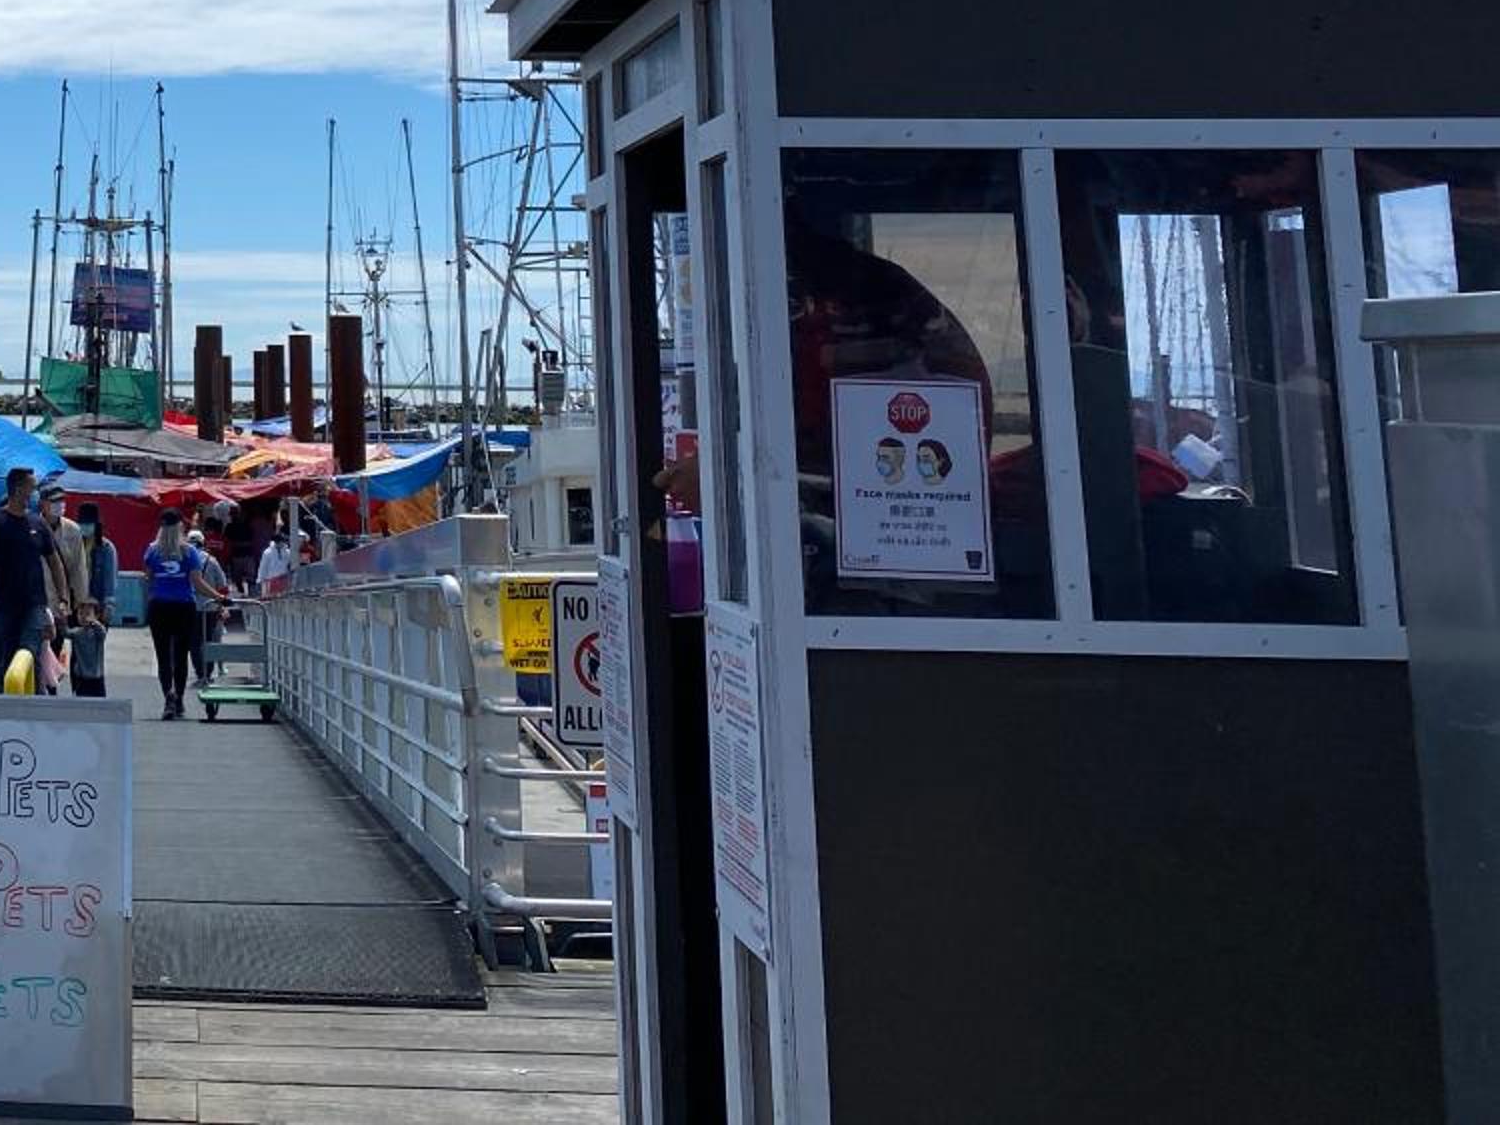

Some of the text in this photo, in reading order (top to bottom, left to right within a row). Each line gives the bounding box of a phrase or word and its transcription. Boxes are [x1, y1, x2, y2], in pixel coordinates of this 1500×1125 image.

[890, 405, 928, 421] STOP
[923, 491, 971, 502] required
[563, 597, 589, 621] NO
[564, 705, 602, 731] ALL
